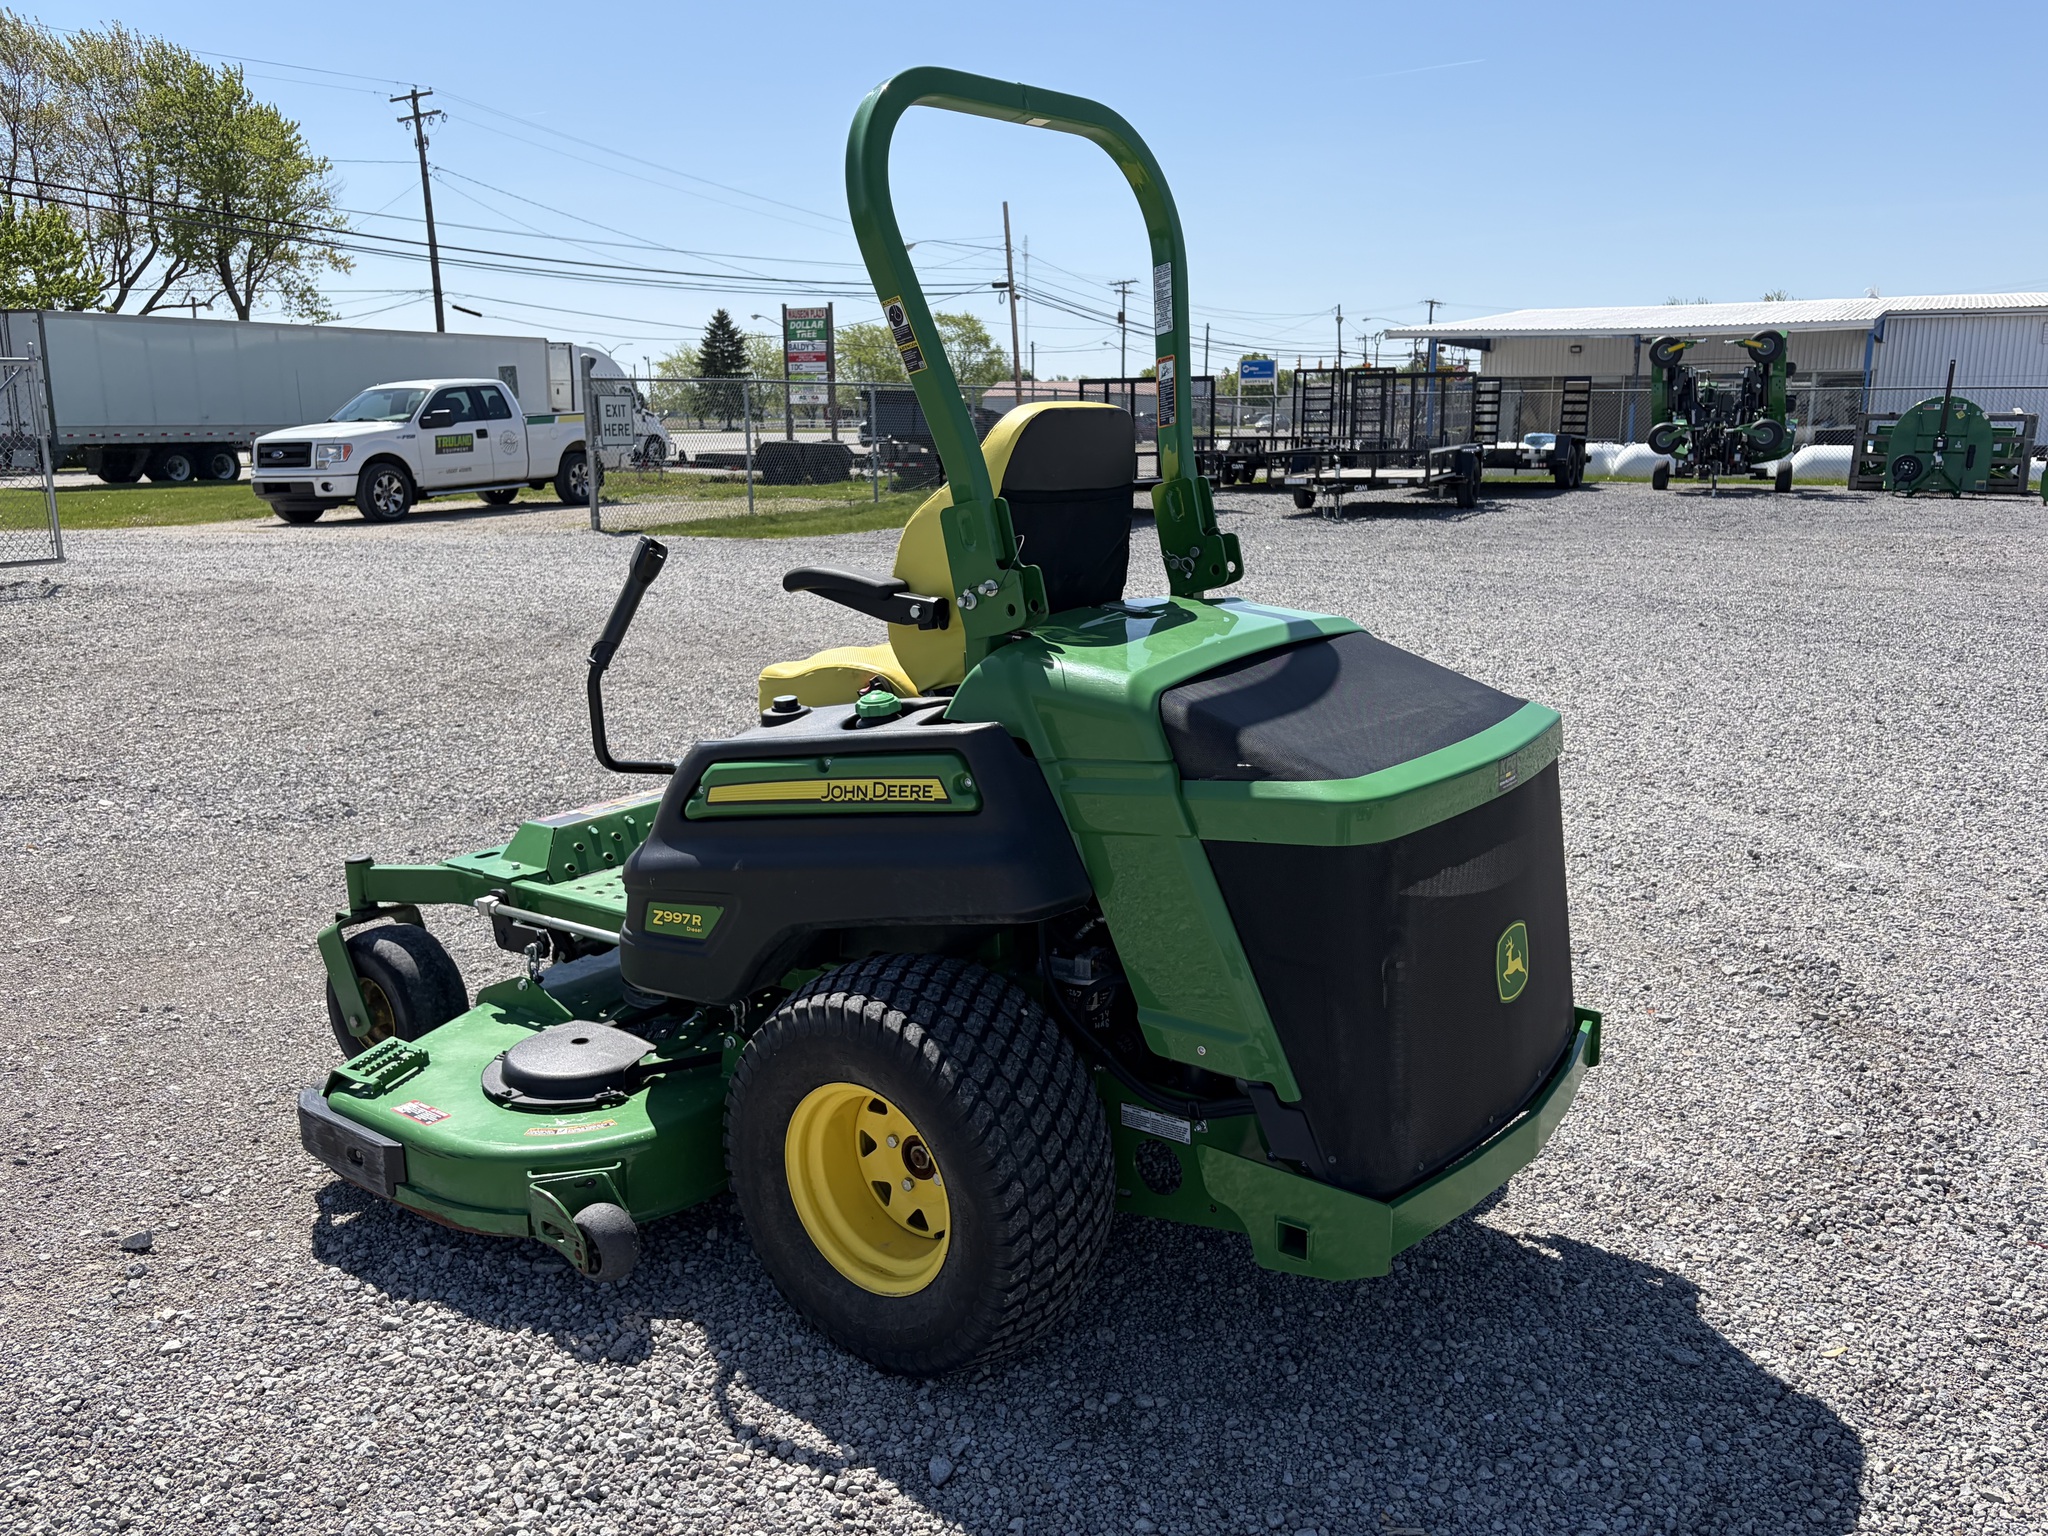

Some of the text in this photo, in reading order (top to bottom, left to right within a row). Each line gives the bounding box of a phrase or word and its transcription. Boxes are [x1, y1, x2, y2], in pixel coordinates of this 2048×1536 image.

[790, 320, 824, 330] DOLLAR
[796, 330, 817, 338] TREE
[788, 343, 816, 351] BALDY'S
[791, 363, 803, 371] TDC
[605, 404, 626, 418] EXIT
[603, 423, 631, 437] HERE
[436, 434, 472, 448] TRULAND
[442, 446, 469, 454] EQUIPMENT
[1354, 484, 1368, 492] CAM
[821, 781, 934, 800] JOHN DEERE
[652, 909, 702, 926] Z997R
